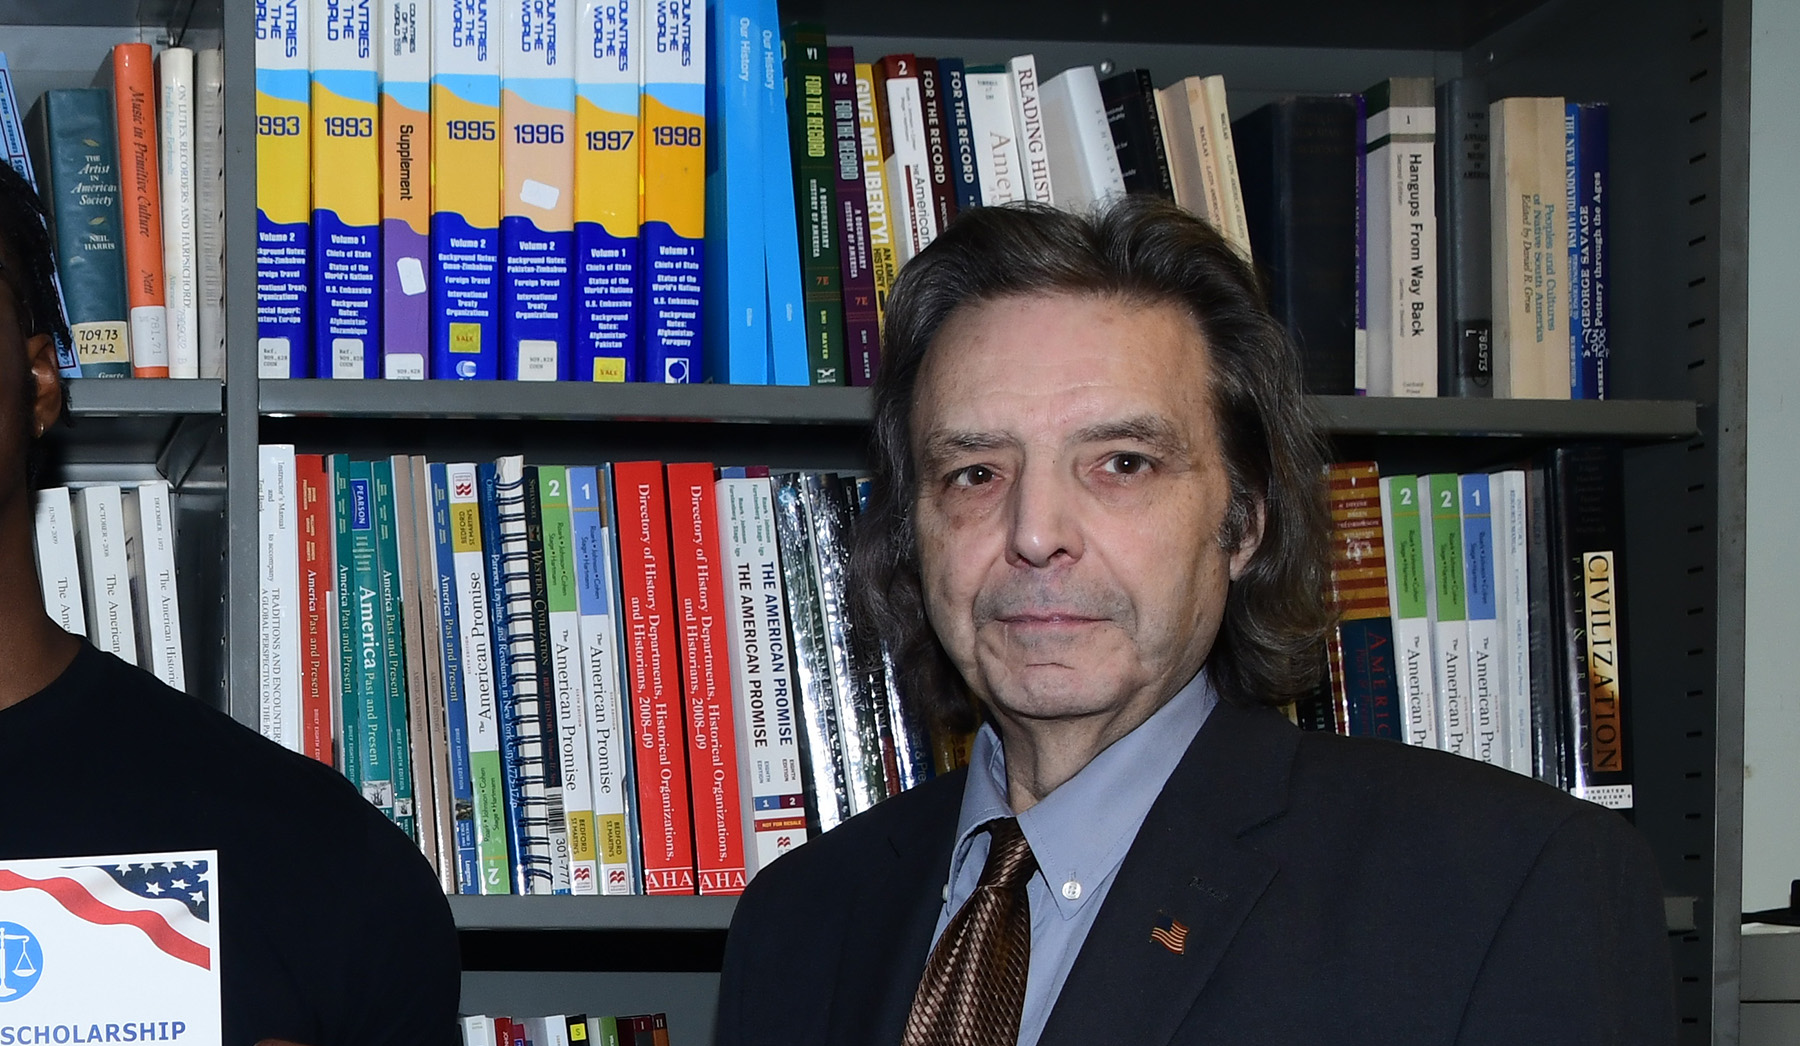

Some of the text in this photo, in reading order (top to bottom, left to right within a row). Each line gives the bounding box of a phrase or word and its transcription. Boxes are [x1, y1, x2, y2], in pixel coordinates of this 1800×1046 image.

[256, 116, 300, 136] 1993
[324, 117, 373, 138] 1993
[446, 120, 497, 141] 1995
[513, 124, 565, 145] 1996
[652, 126, 702, 147] 1998
[922, 70, 946, 185] FOR THE RECORD
[585, 131, 635, 151] 1997
[78, 163, 110, 174] Artist
[130, 86, 151, 238] Music in Primitive Culture
[396, 124, 414, 201] Supplement
[855, 78, 889, 245] GIVE ME LIBERTY!
[79, 194, 114, 206] Society
[84, 242, 115, 250] HARRIS
[89, 235, 109, 243] NEIL
[1406, 153, 1424, 337] Hangups From Way Back
[1579, 205, 1590, 328] GEORGE SAVAGE
[79, 329, 119, 341] 709.73
[357, 485, 365, 524] PEARSON
[631, 596, 641, 620] and
[634, 622, 648, 695] Historians,
[760, 562, 794, 746] THE AMERICAN PROMISE
[1588, 554, 1617, 770] CIVILIZATION
[637, 483, 674, 861] Directory of History Departments, Historical Organizations,
[646, 868, 693, 888] AHA
[0, 1021, 187, 1045] SCHOLARSHIP
